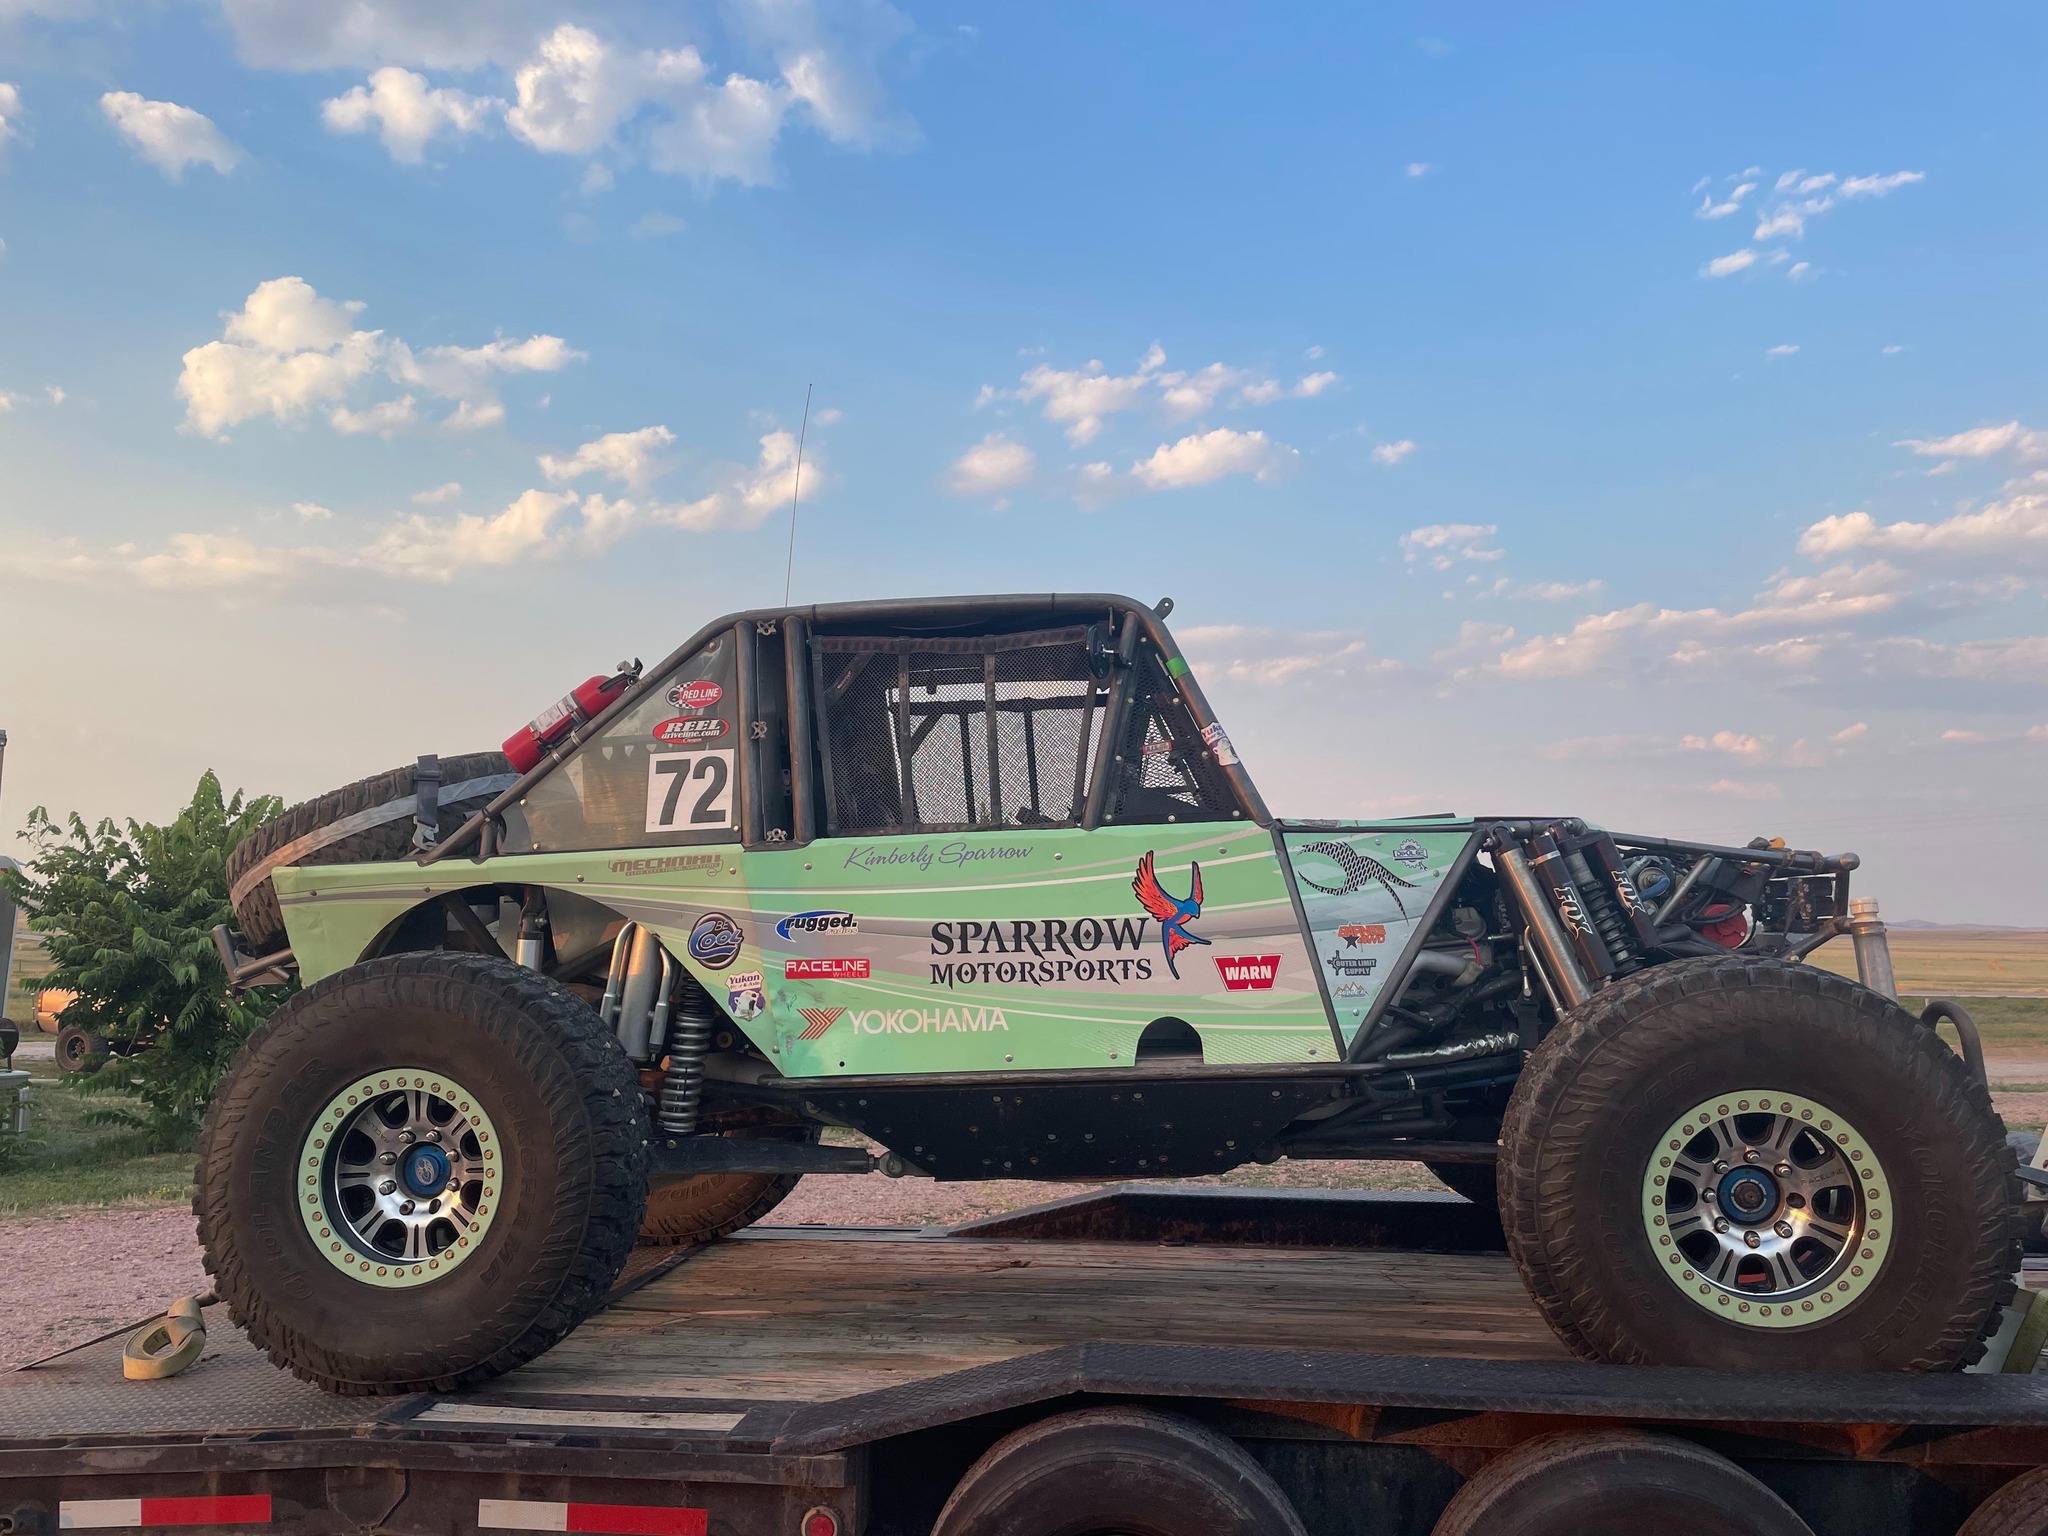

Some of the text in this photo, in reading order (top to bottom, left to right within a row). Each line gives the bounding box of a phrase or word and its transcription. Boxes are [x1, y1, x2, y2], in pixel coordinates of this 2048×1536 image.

[682, 689, 699, 700] RED
[700, 688, 719, 698] LINE
[665, 719, 721, 733] REEL
[661, 729, 721, 740] driveline.com
[655, 755, 730, 827] 72
[843, 842, 1034, 871] Kimberly Sparrow
[1611, 870, 1647, 918] FOX
[1553, 887, 1594, 941] FOX
[714, 920, 730, 931] BE
[930, 917, 1150, 959] SPARROW
[786, 960, 867, 973] RACELINE
[1336, 958, 1376, 968] OUTER LIMIT
[930, 957, 1152, 989] MOTORSPORTS
[1224, 964, 1272, 981] WARN
[1345, 967, 1371, 976] SUPPLY
[729, 974, 760, 985] Yukon
[847, 1006, 1009, 1034] YOKOHAMA
